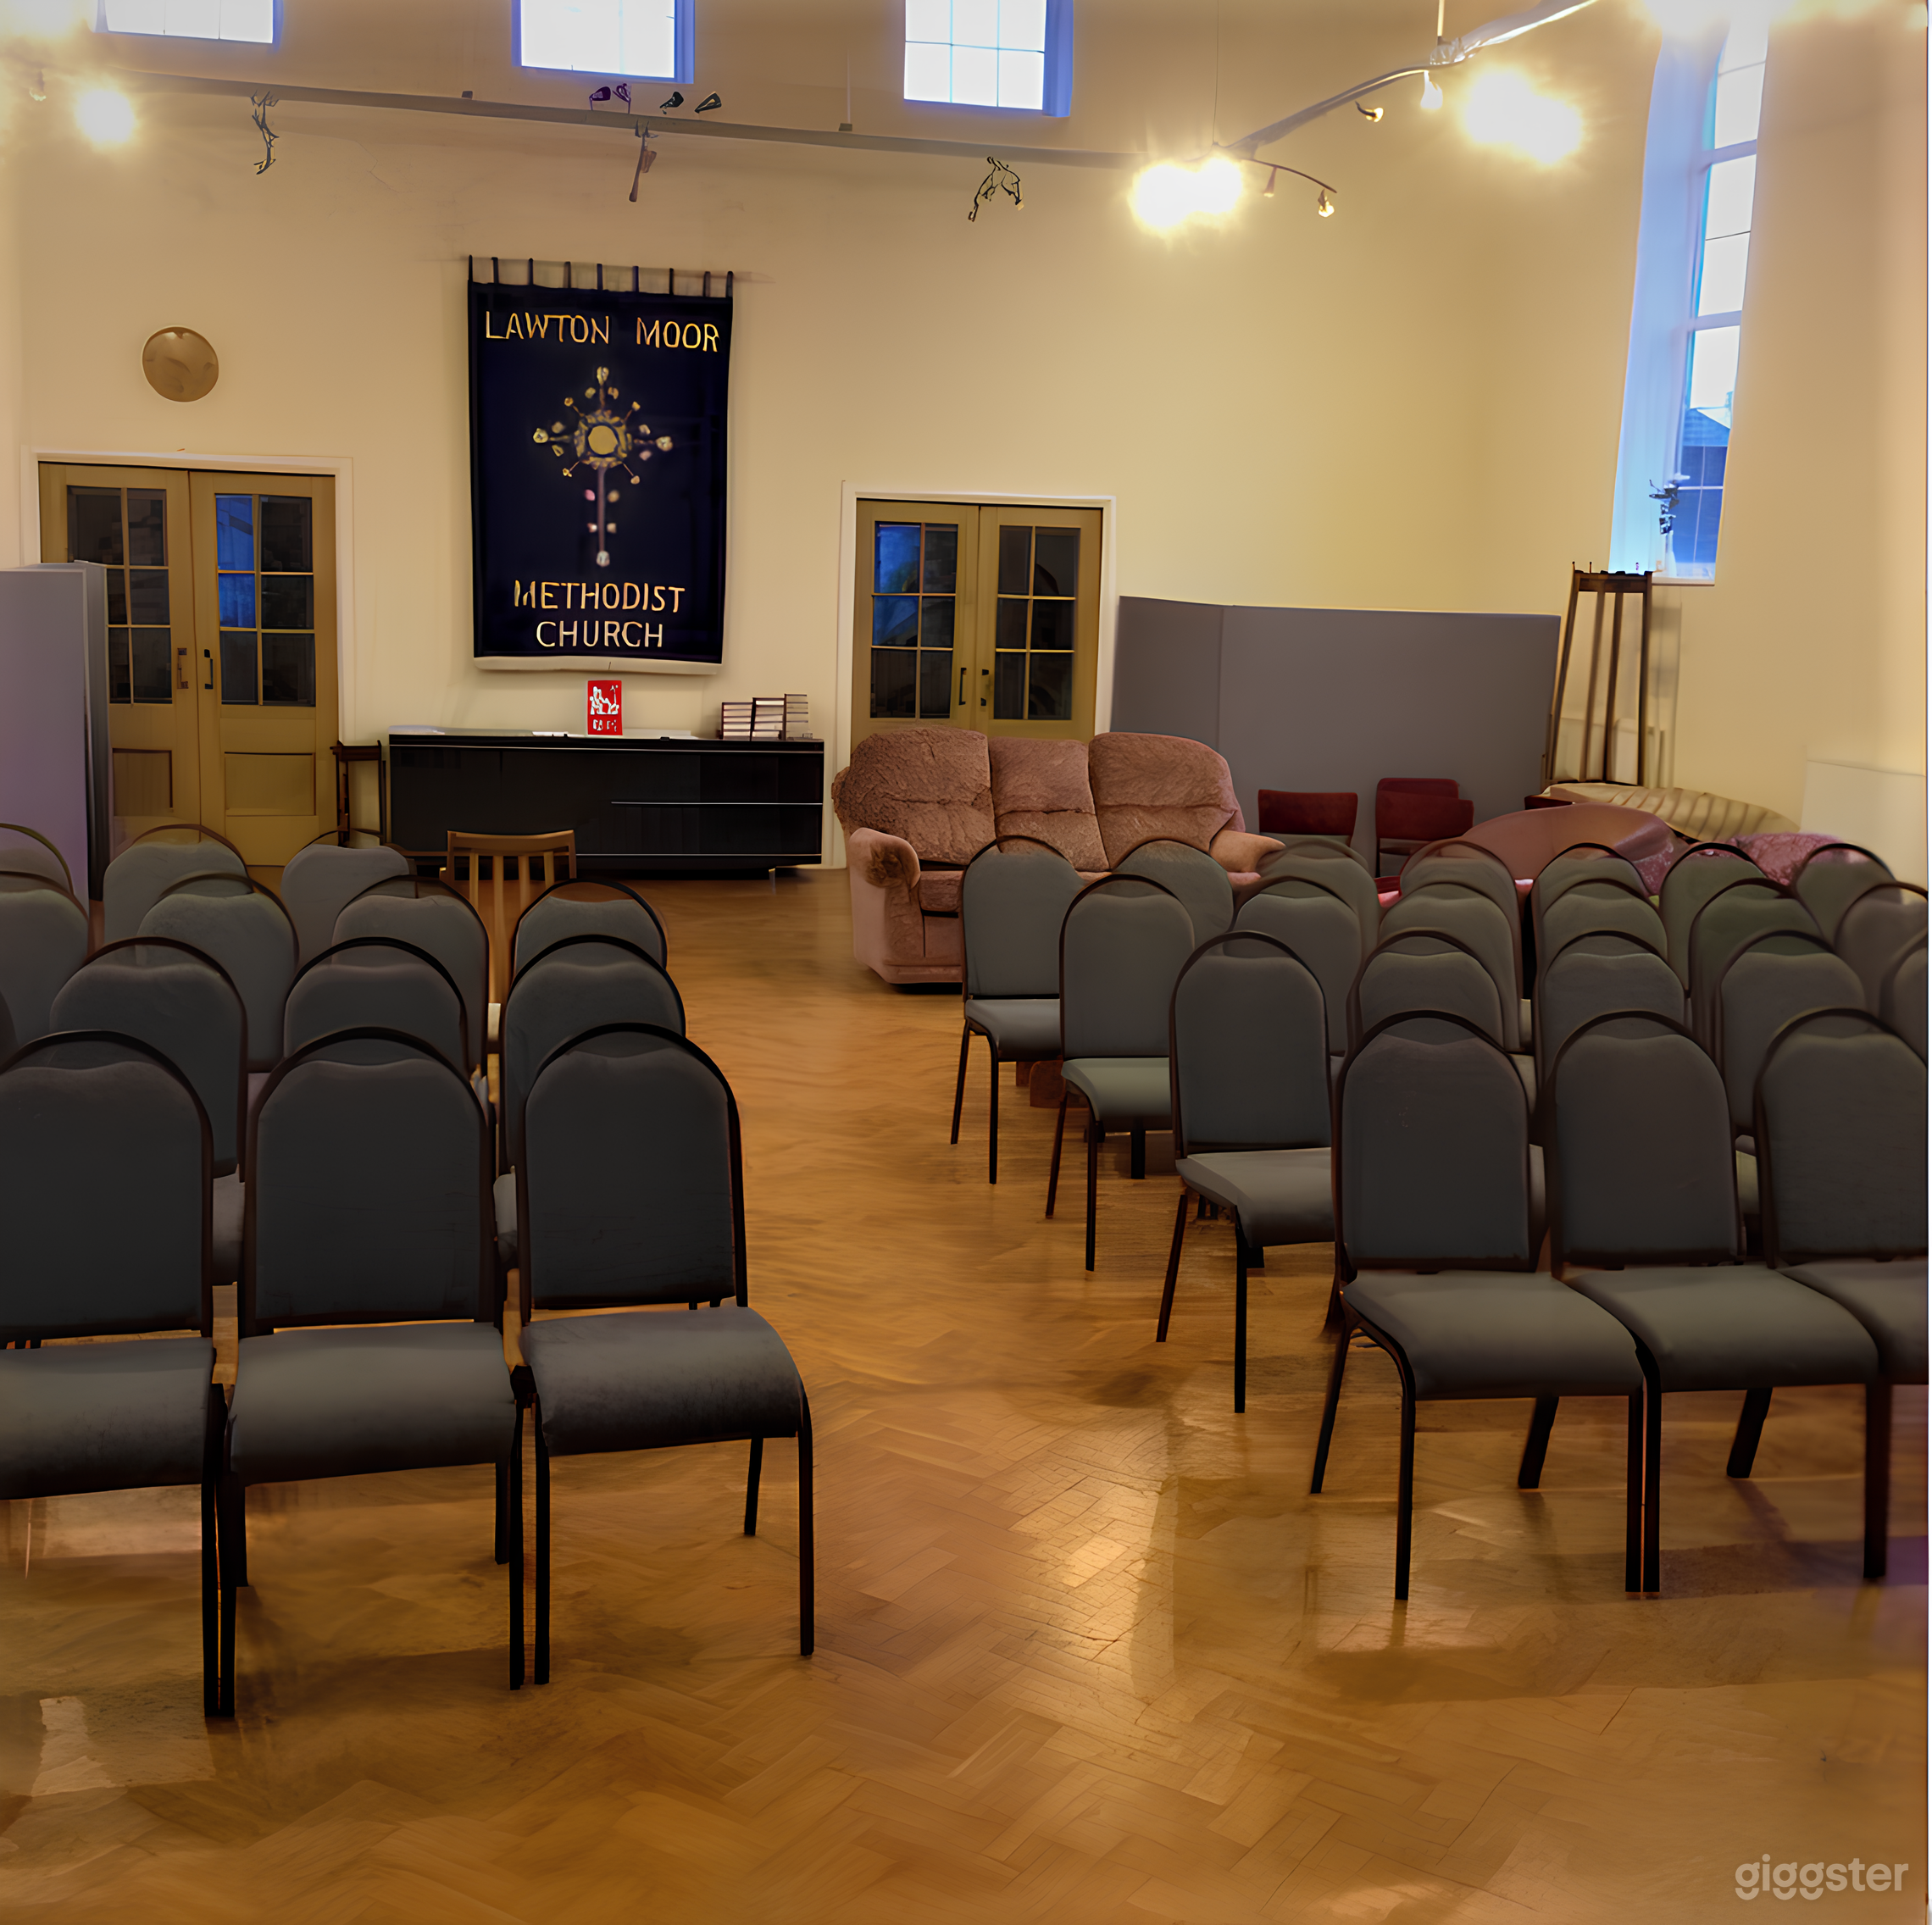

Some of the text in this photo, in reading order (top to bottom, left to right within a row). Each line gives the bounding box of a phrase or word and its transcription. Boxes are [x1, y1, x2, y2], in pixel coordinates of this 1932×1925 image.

[486, 310, 719, 352] LAWTON MOOR
[514, 580, 685, 613] METHODIST
[536, 620, 663, 647] CHURCH
